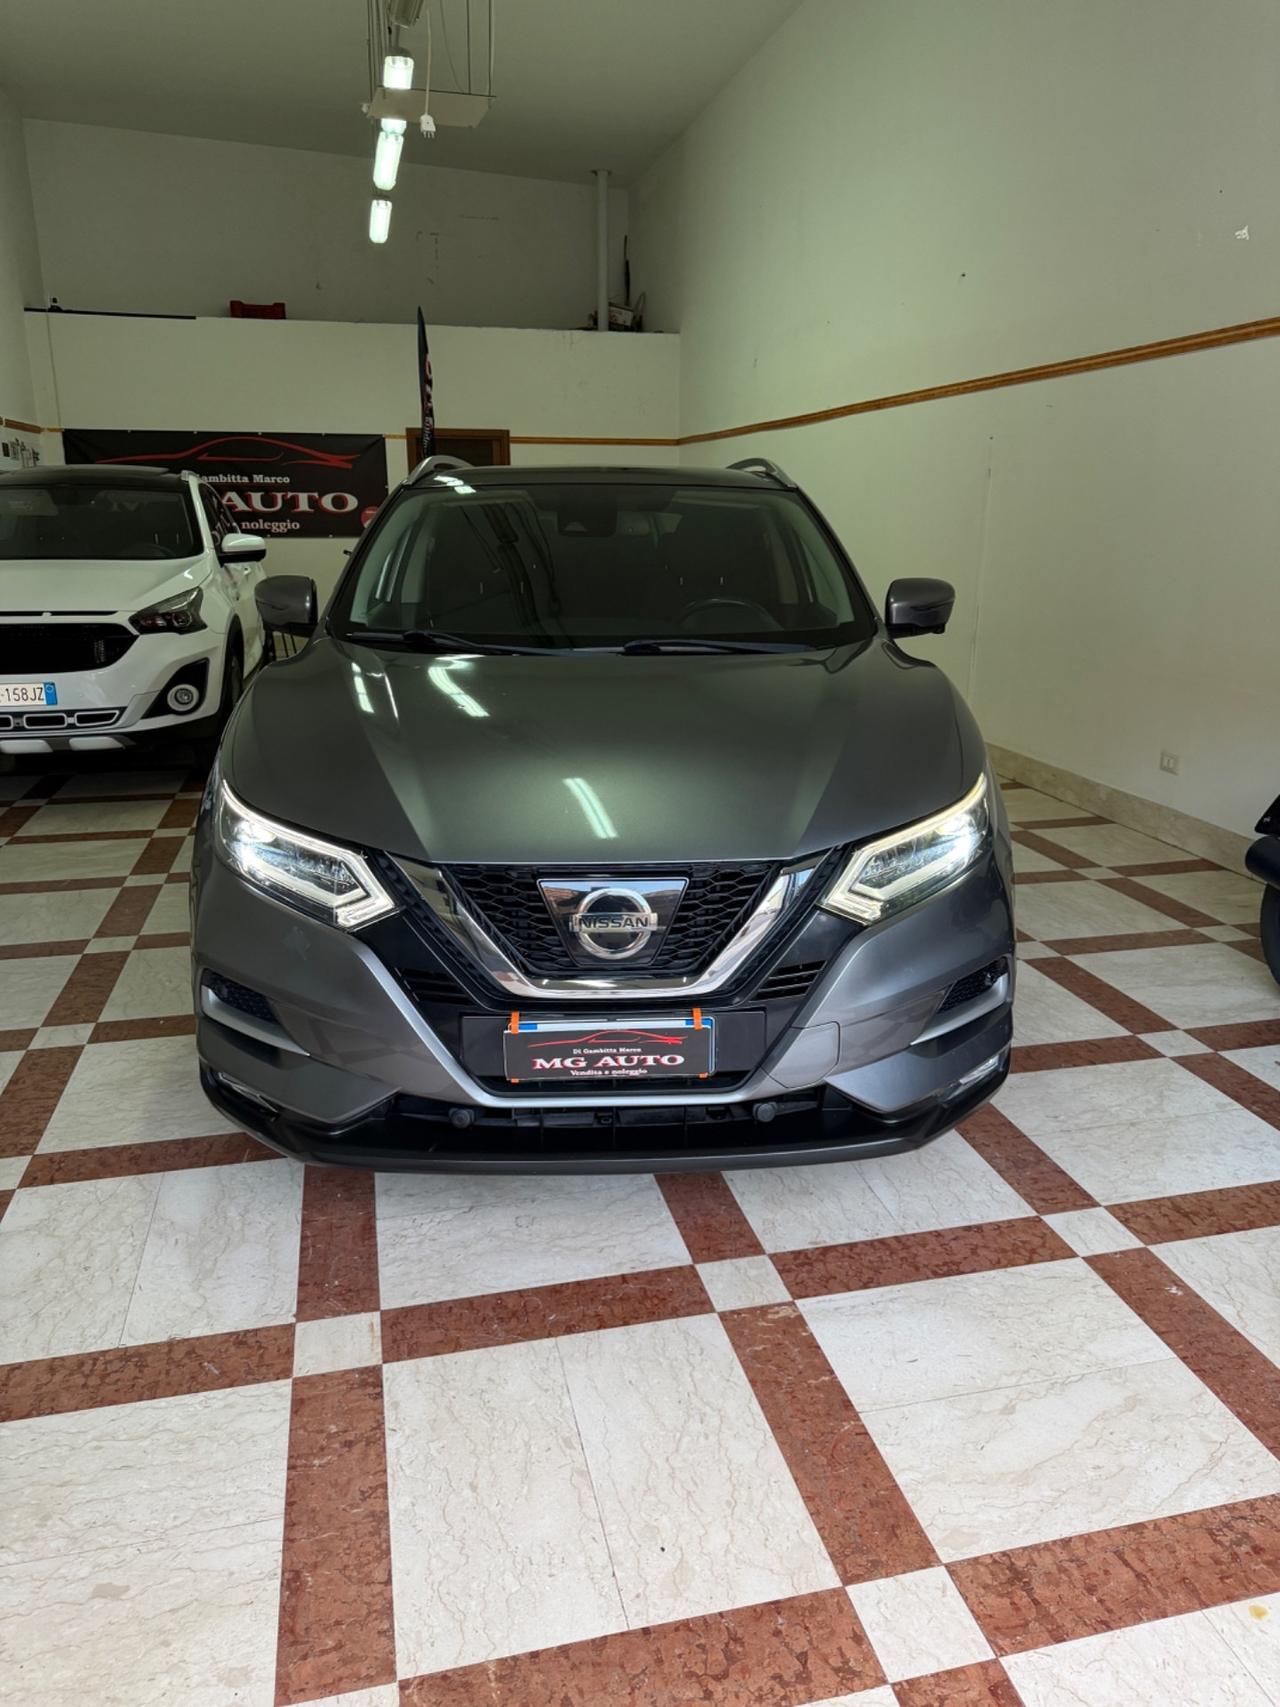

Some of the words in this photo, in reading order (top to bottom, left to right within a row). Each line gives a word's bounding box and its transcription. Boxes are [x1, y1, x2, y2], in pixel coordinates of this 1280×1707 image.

[200, 474, 249, 484] ambitta
[252, 474, 290, 484] Marco
[222, 491, 359, 513] AUTO
[241, 519, 301, 533] noleggio
[580, 915, 649, 929] NISSAN
[532, 1057, 588, 1070] MG
[593, 1054, 686, 1068] AUTO
